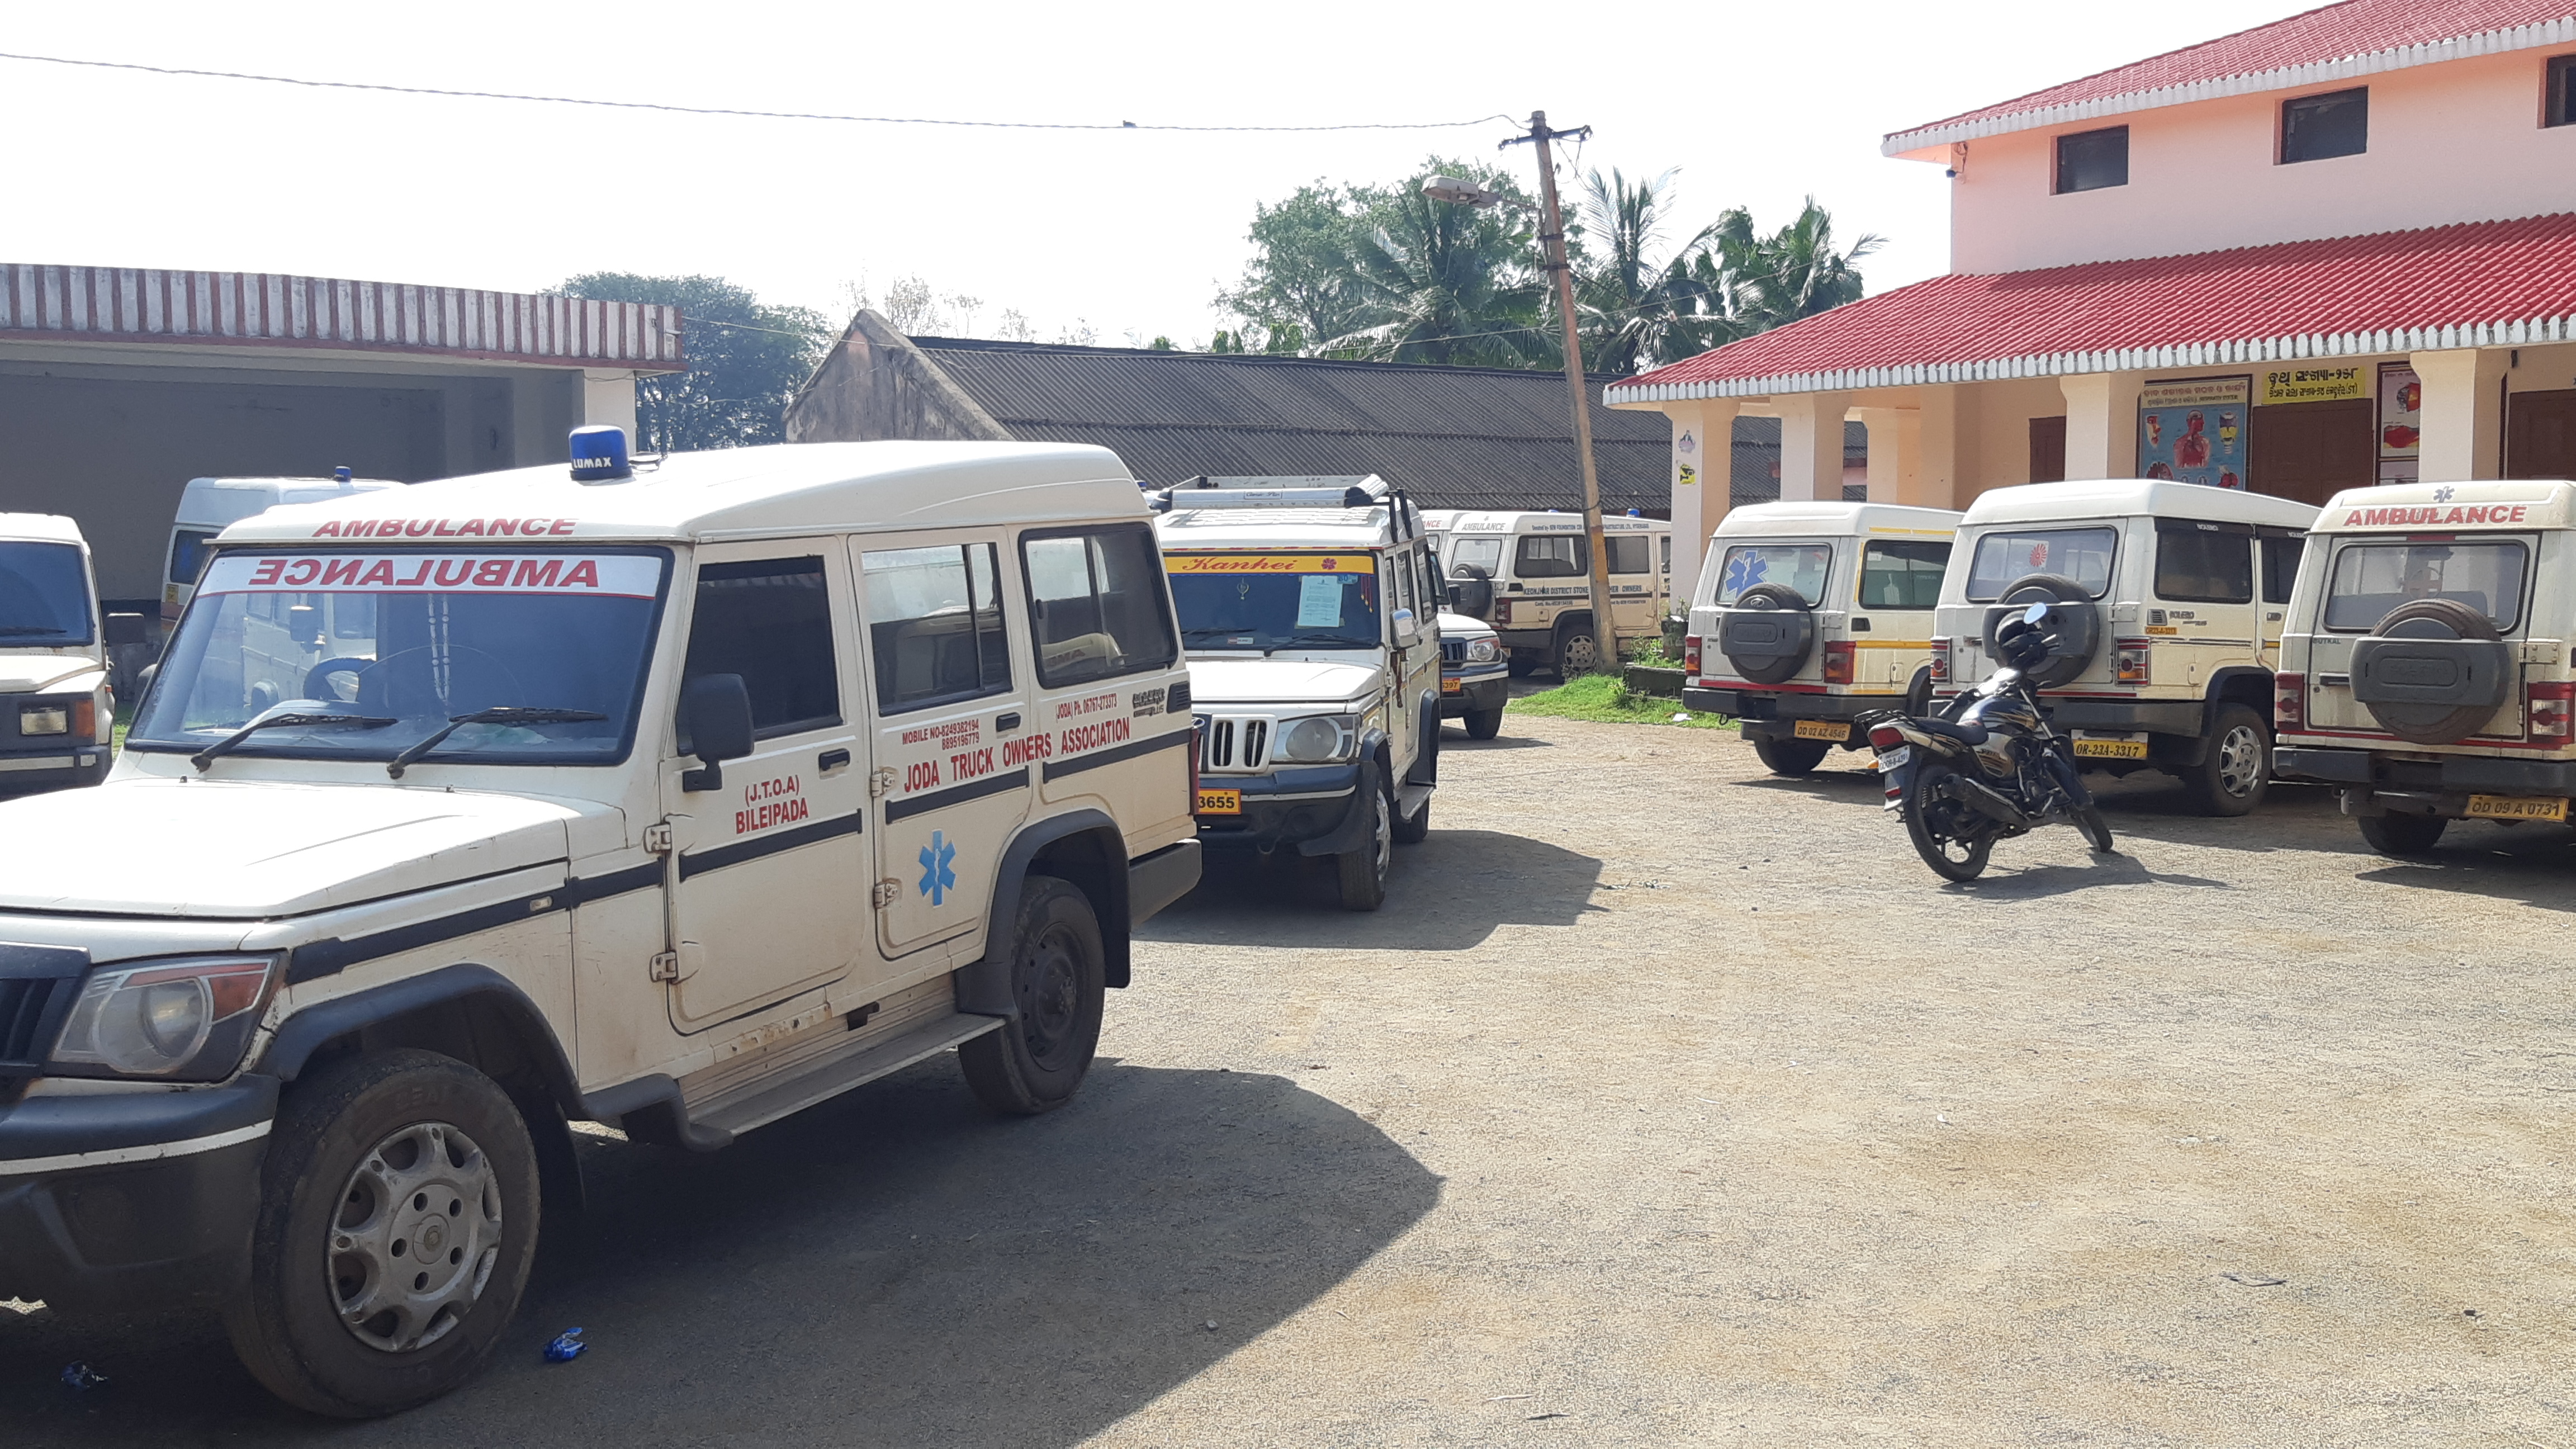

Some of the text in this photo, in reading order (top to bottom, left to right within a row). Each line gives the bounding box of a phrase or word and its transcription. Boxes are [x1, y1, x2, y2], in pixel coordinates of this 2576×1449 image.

[573, 456, 612, 469] LUMAX
[2343, 505, 2527, 527] AMBULANCE
[312, 518, 580, 537] AMBULANCE
[1182, 557, 1298, 570] Kanhei
[902, 728, 929, 745] MOBILE
[1817, 728, 1827, 737] AZ
[903, 717, 1130, 793] JODA TRUCK OWNERS ASSOCIATION
[2076, 744, 2139, 757] OR-23A-3317
[745, 774, 799, 807] (J.T.O.A)
[1198, 796, 1235, 808] 3655
[2494, 802, 2511, 814] 09
[2513, 803, 2523, 815] A
[2527, 802, 2560, 816] 0731
[736, 797, 809, 835] BILEIPADA
